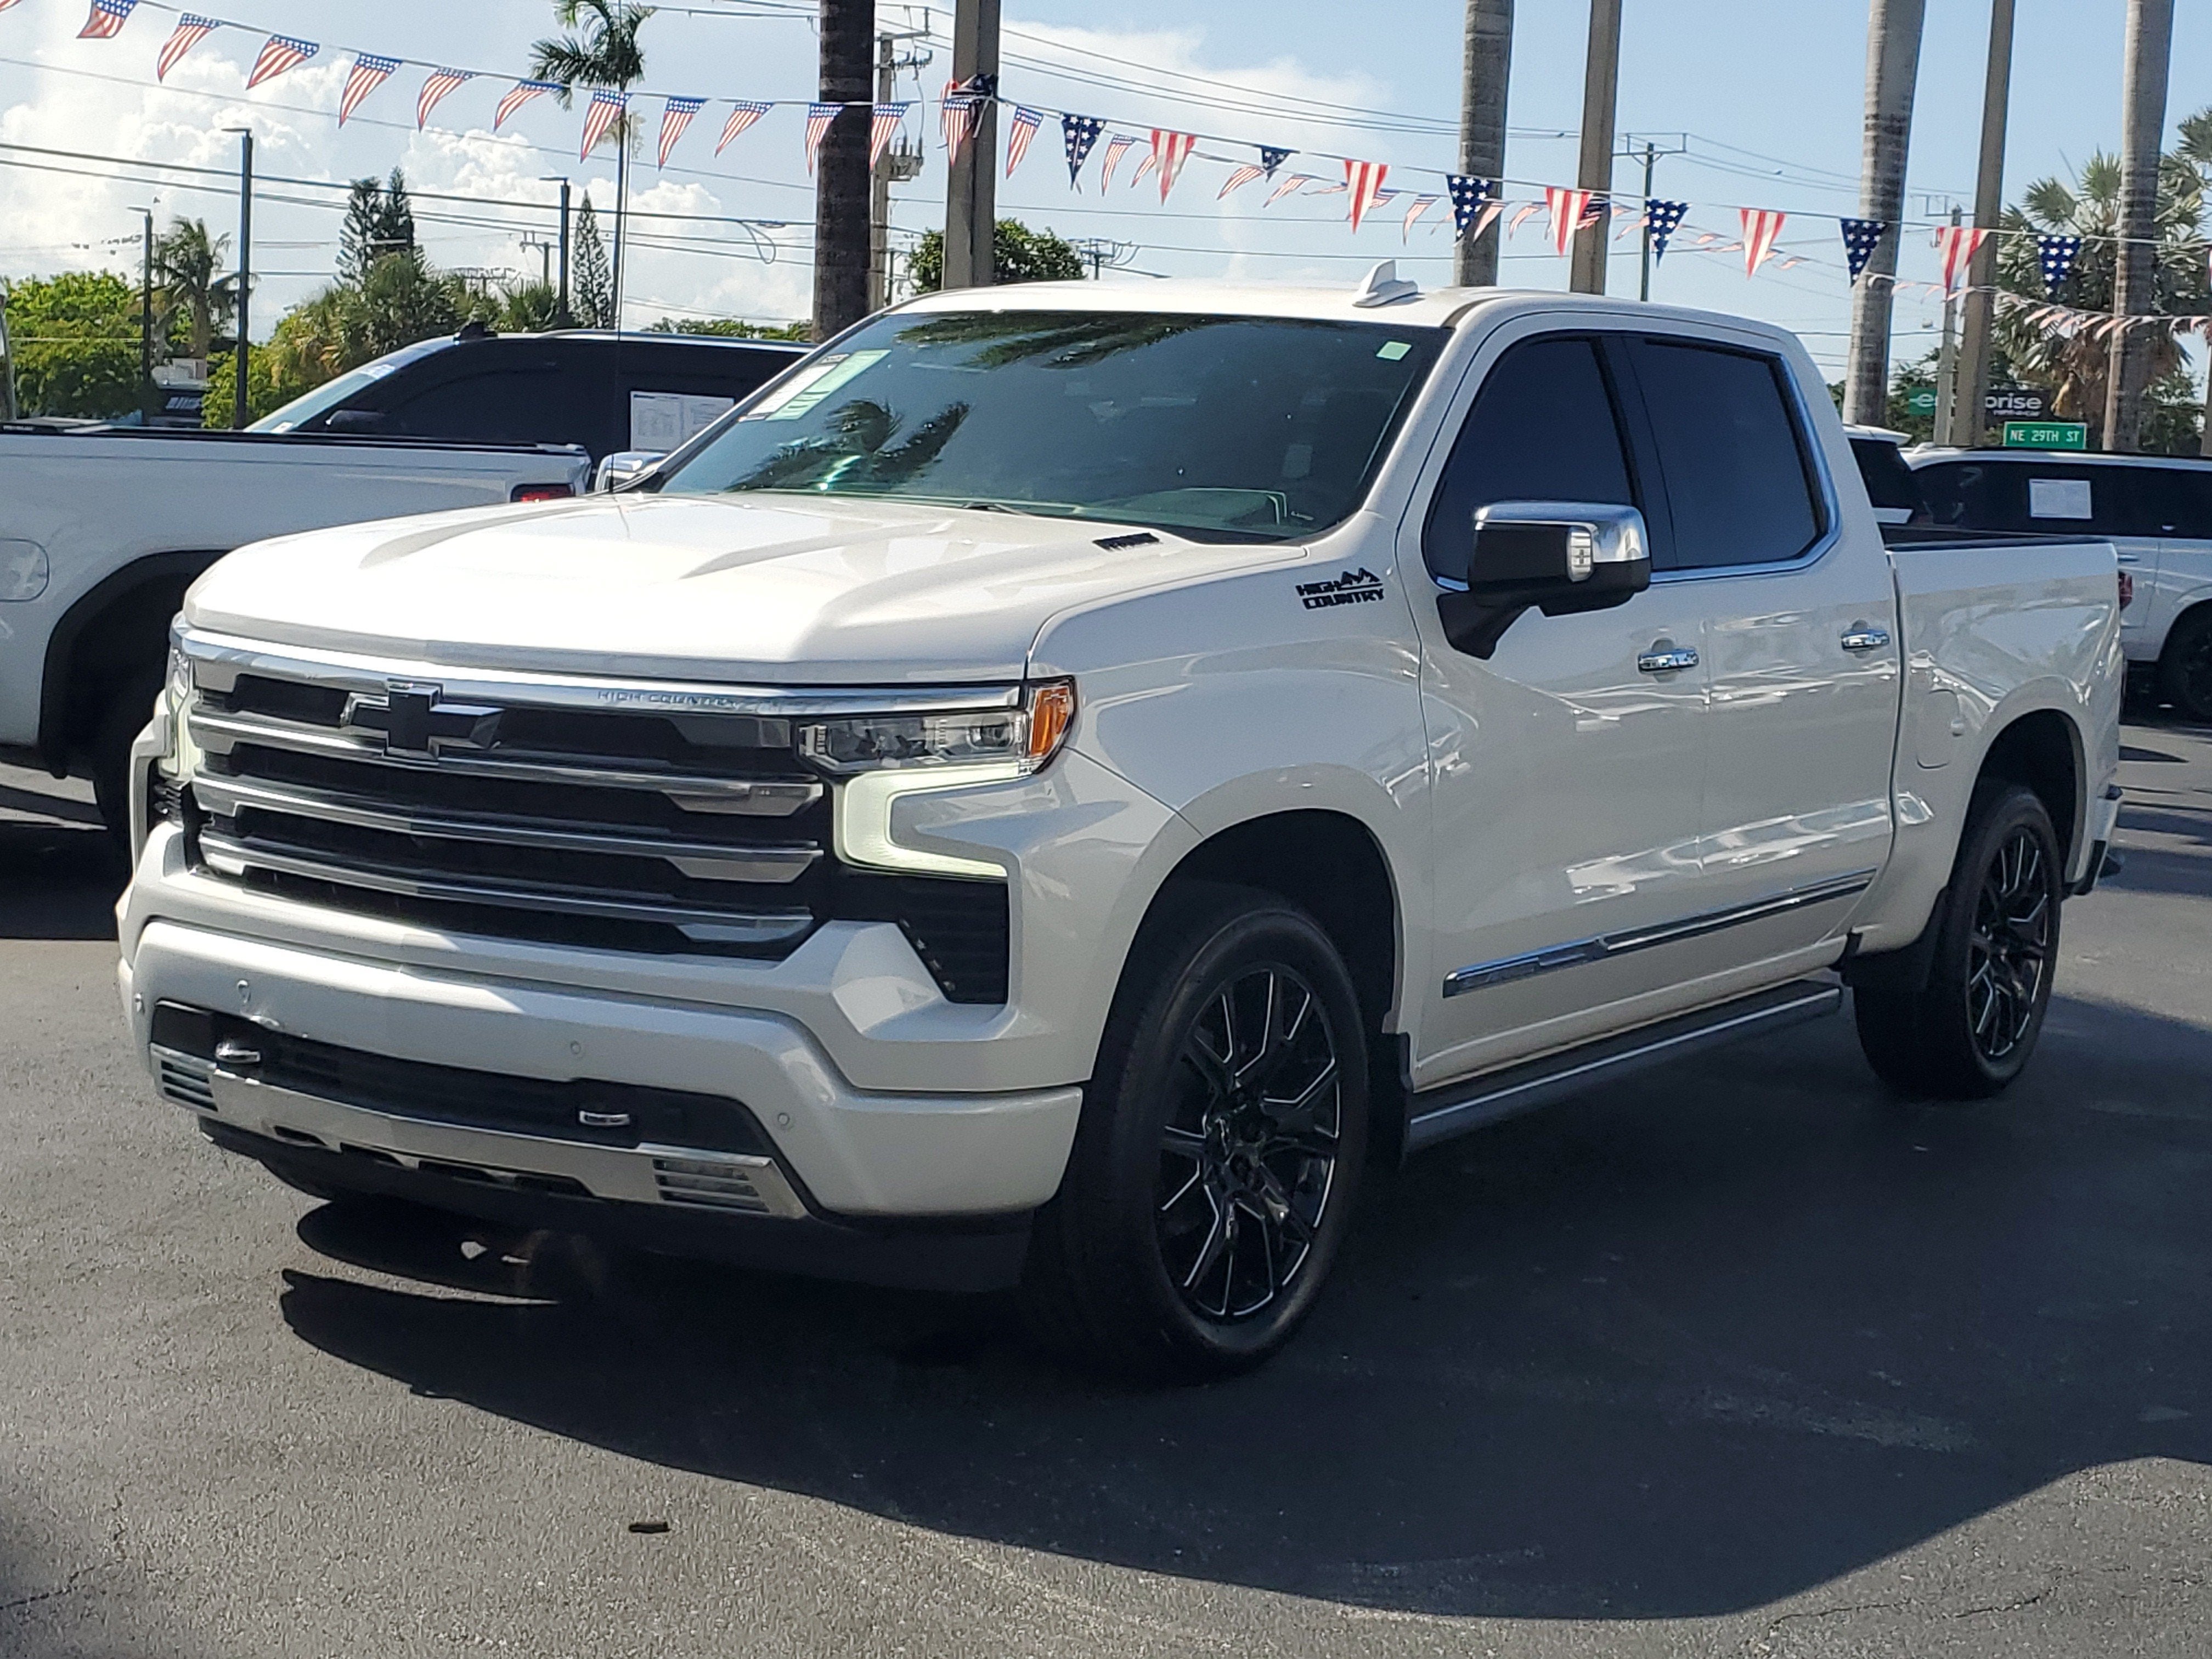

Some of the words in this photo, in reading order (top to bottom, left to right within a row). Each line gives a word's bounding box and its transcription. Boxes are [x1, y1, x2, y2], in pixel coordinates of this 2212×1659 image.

[2010, 430, 2025, 441] NE
[2031, 430, 2059, 442] 29TH
[2066, 431, 2080, 442] ST
[1296, 580, 1341, 596] HIGH
[1302, 588, 1384, 610] COUNTRY
[597, 690, 644, 703] HIGH
